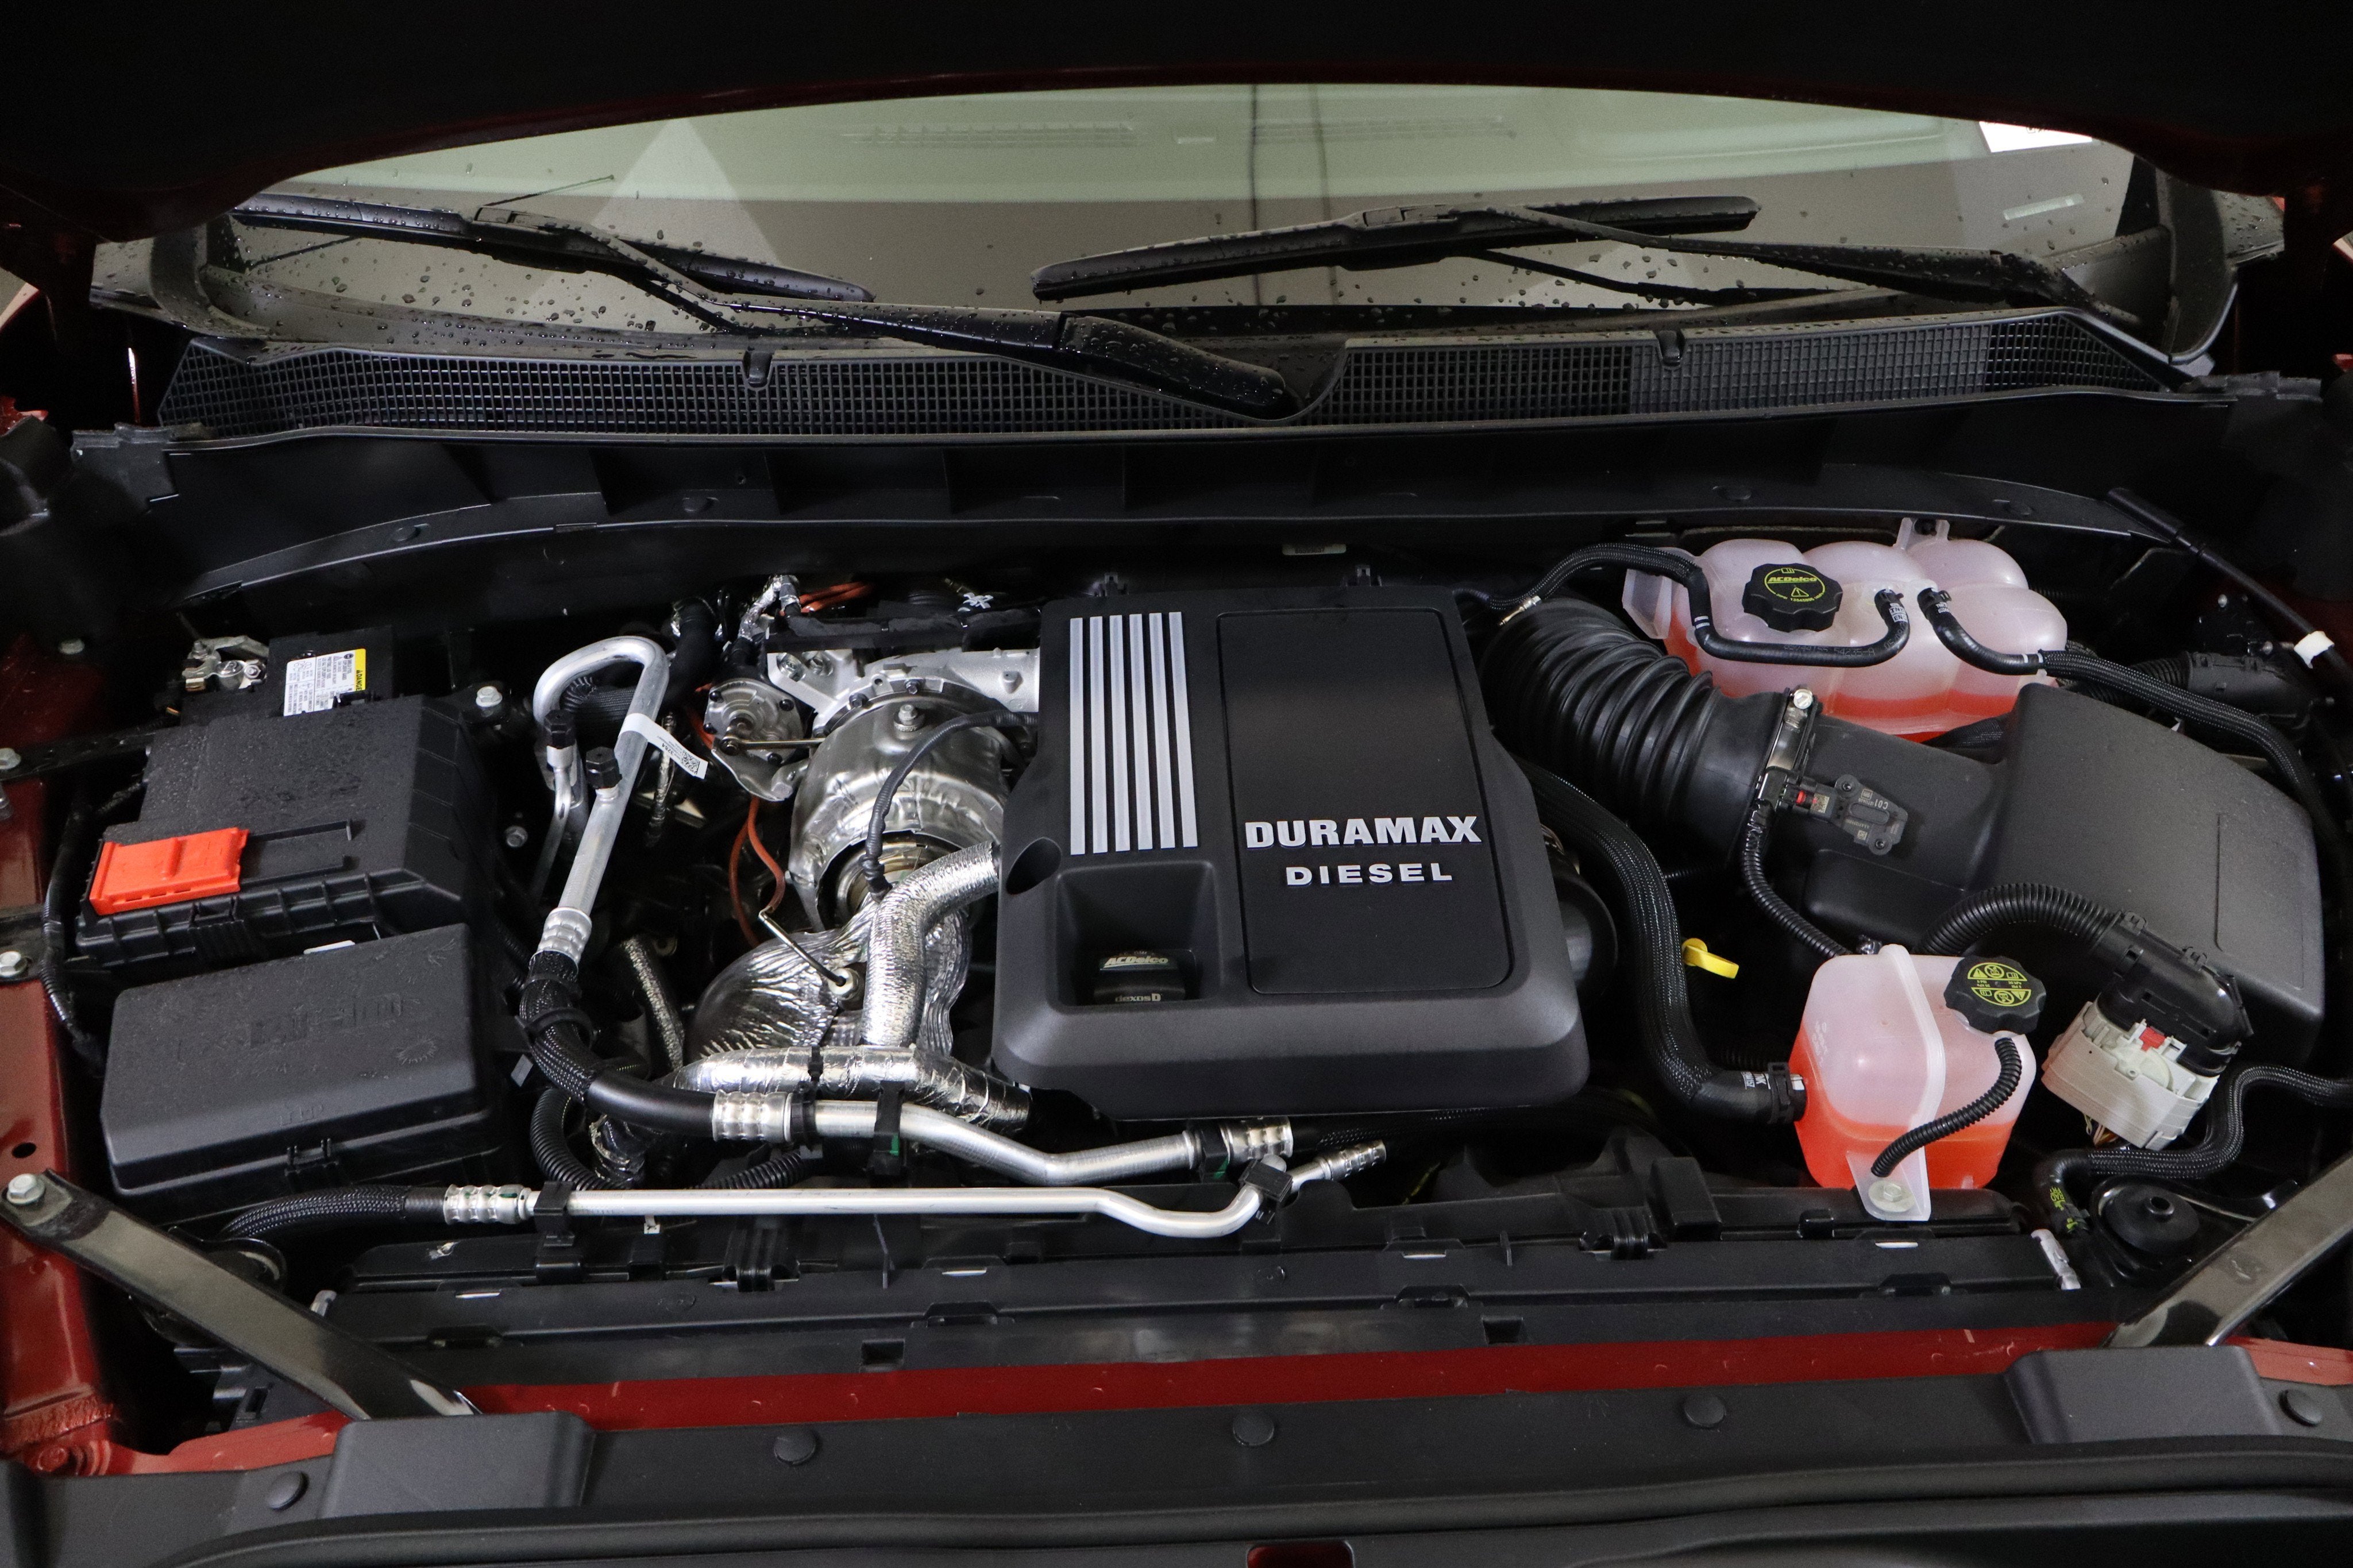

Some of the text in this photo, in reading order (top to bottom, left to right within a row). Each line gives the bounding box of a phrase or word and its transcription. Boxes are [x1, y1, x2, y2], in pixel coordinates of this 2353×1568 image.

[1245, 816, 1482, 848] DURAMAX
[1286, 863, 1453, 886] DIESEL
[1105, 956, 1168, 965] ACDelco
